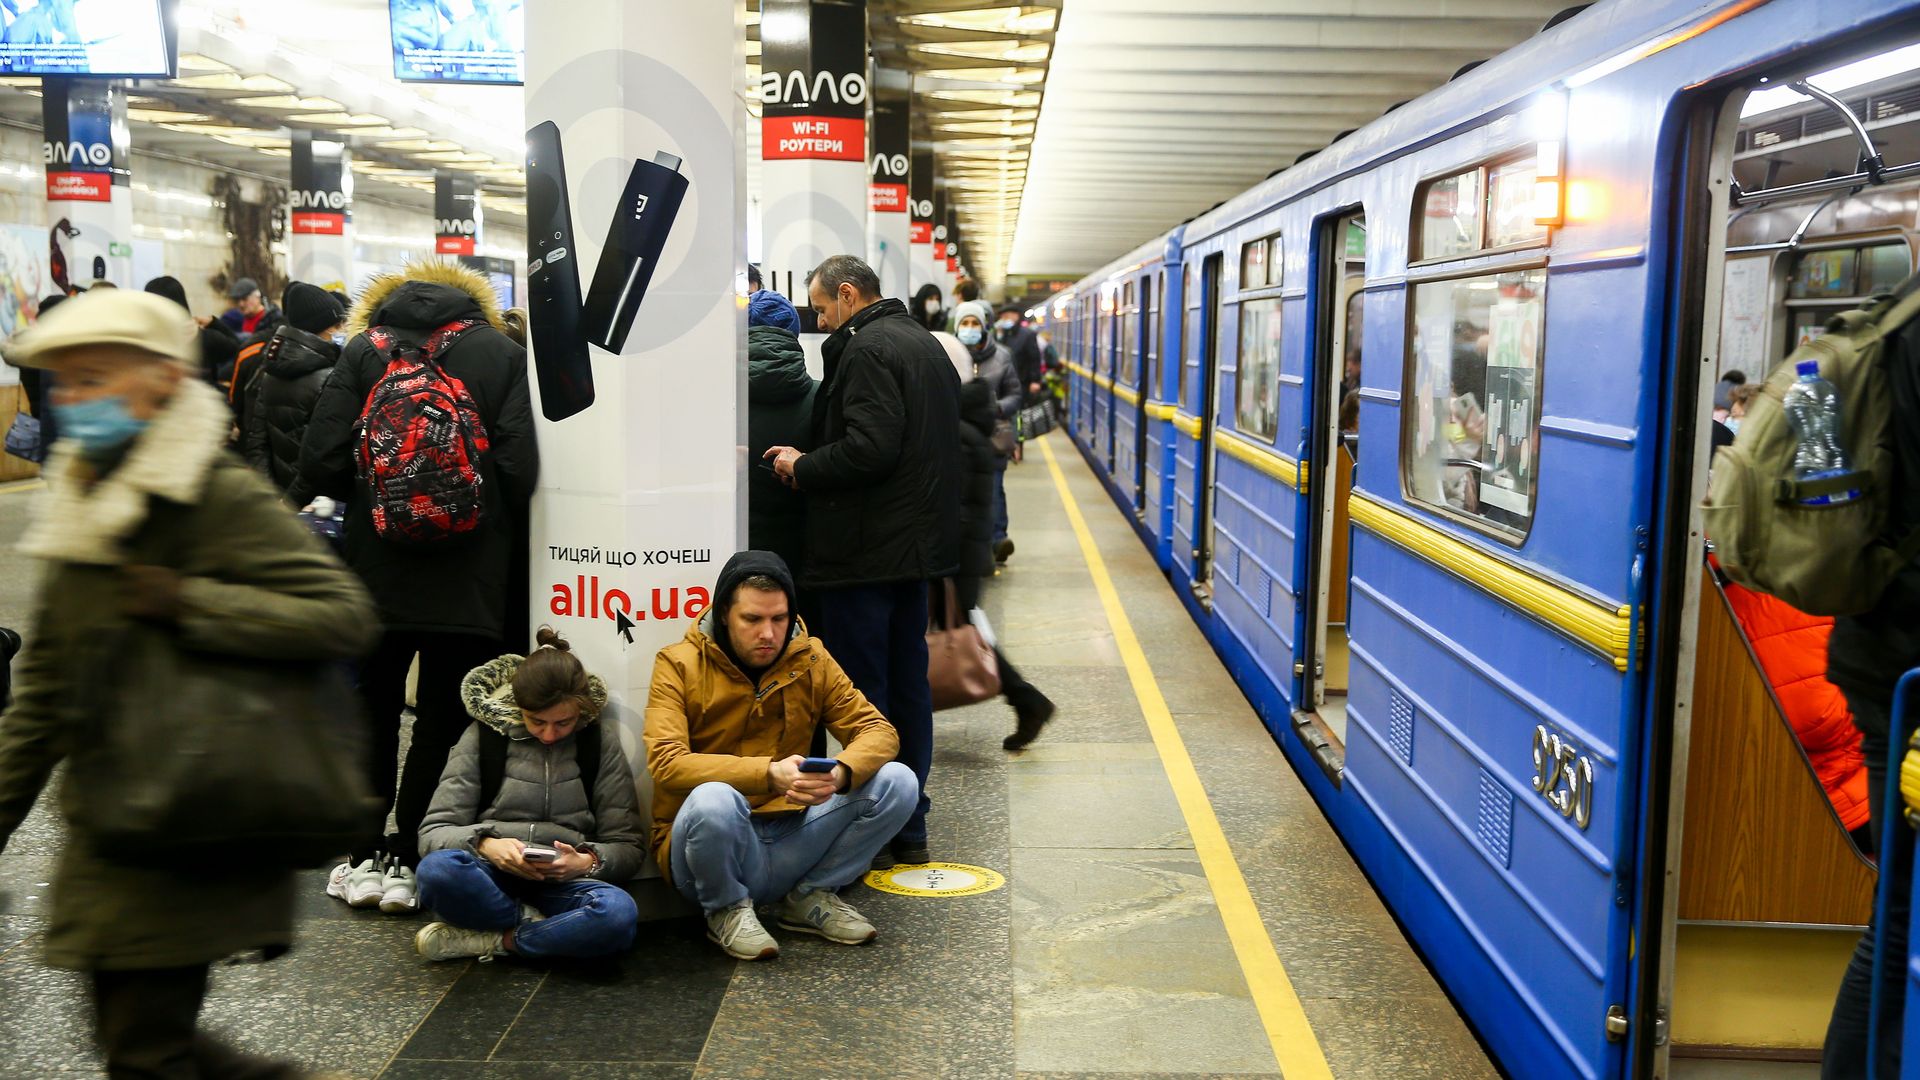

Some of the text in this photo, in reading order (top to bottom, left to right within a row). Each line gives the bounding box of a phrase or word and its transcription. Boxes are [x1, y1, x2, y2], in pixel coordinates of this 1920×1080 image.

[792, 121, 829, 135] WI-FI
[779, 138, 843, 153] РОУТЕРИ
[411, 503, 458, 520] SPORTS
[548, 545, 711, 568] ТИЦЯЙ ЩО ХОЧЕШ
[550, 574, 710, 621] allo.ua
[1532, 724, 1594, 832] 9250
